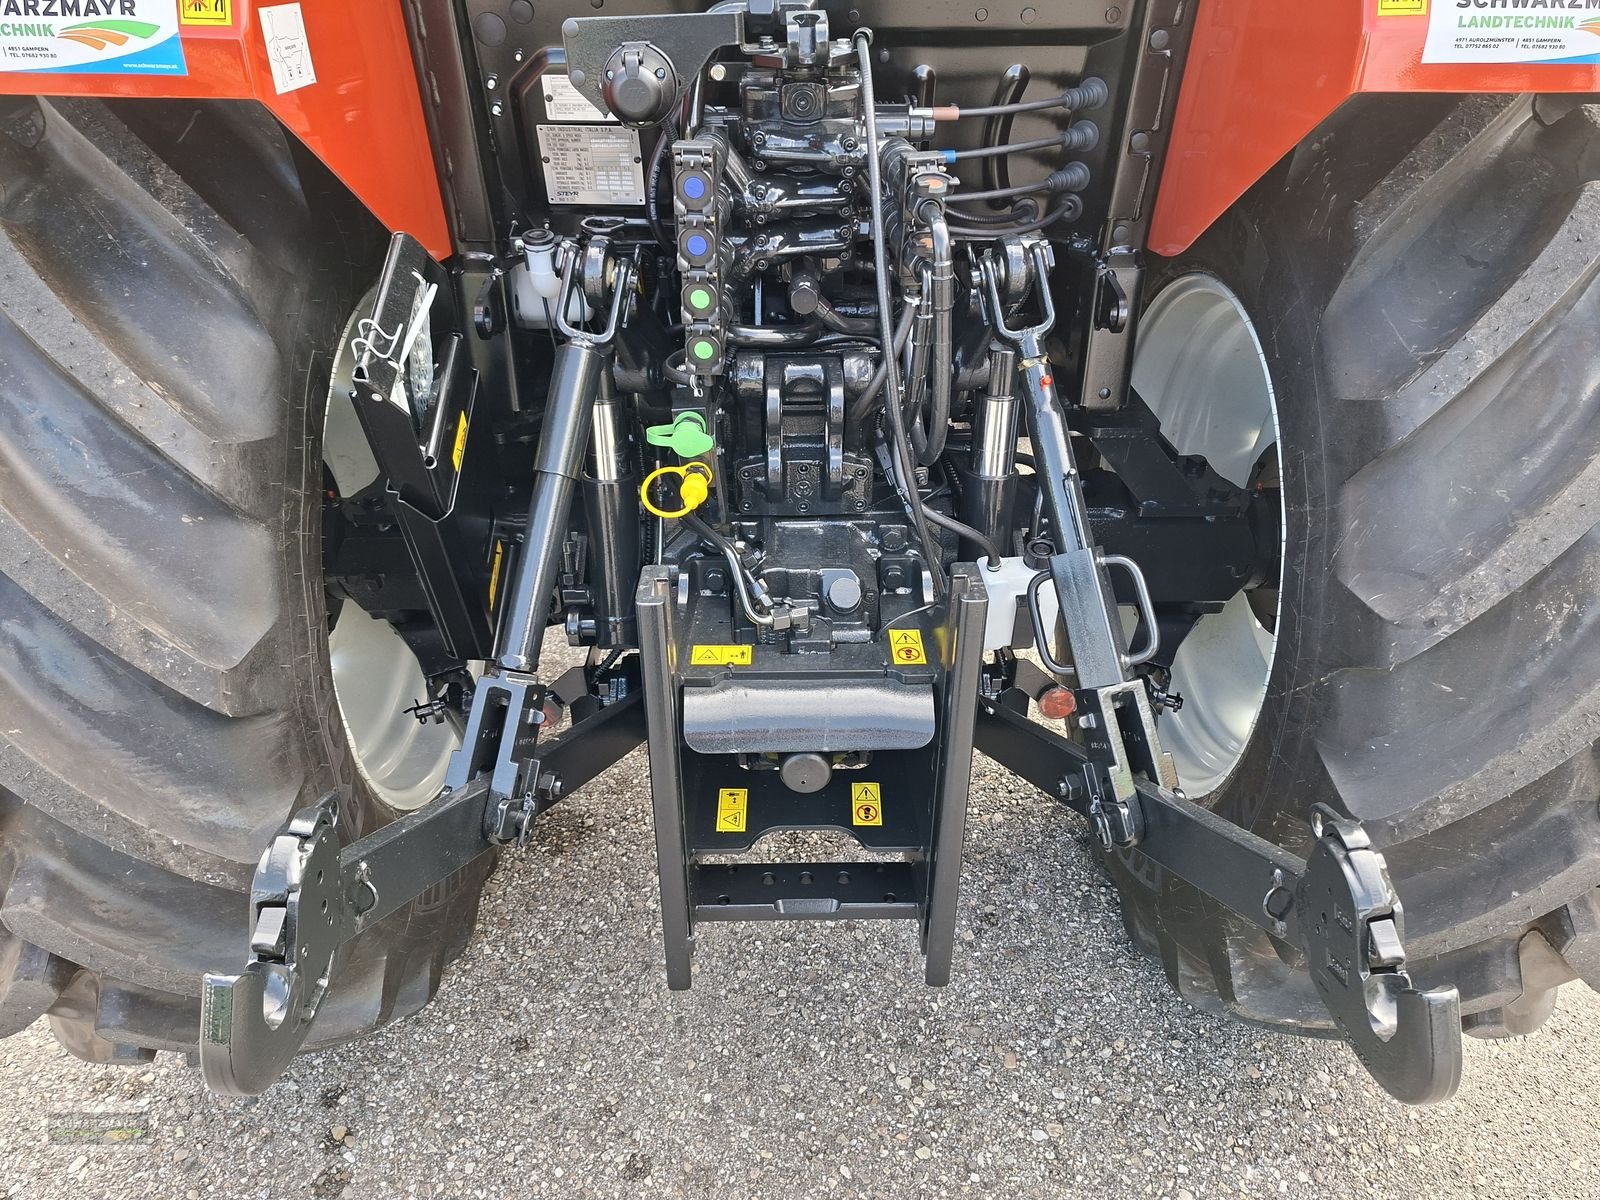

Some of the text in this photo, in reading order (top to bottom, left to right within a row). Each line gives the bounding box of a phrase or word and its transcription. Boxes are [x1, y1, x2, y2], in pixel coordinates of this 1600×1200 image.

[0, 0, 136, 16] ARZMAYR
[1457, 15, 1575, 28] LANDTECHNIK
[0, 23, 55, 37] CHNIK
